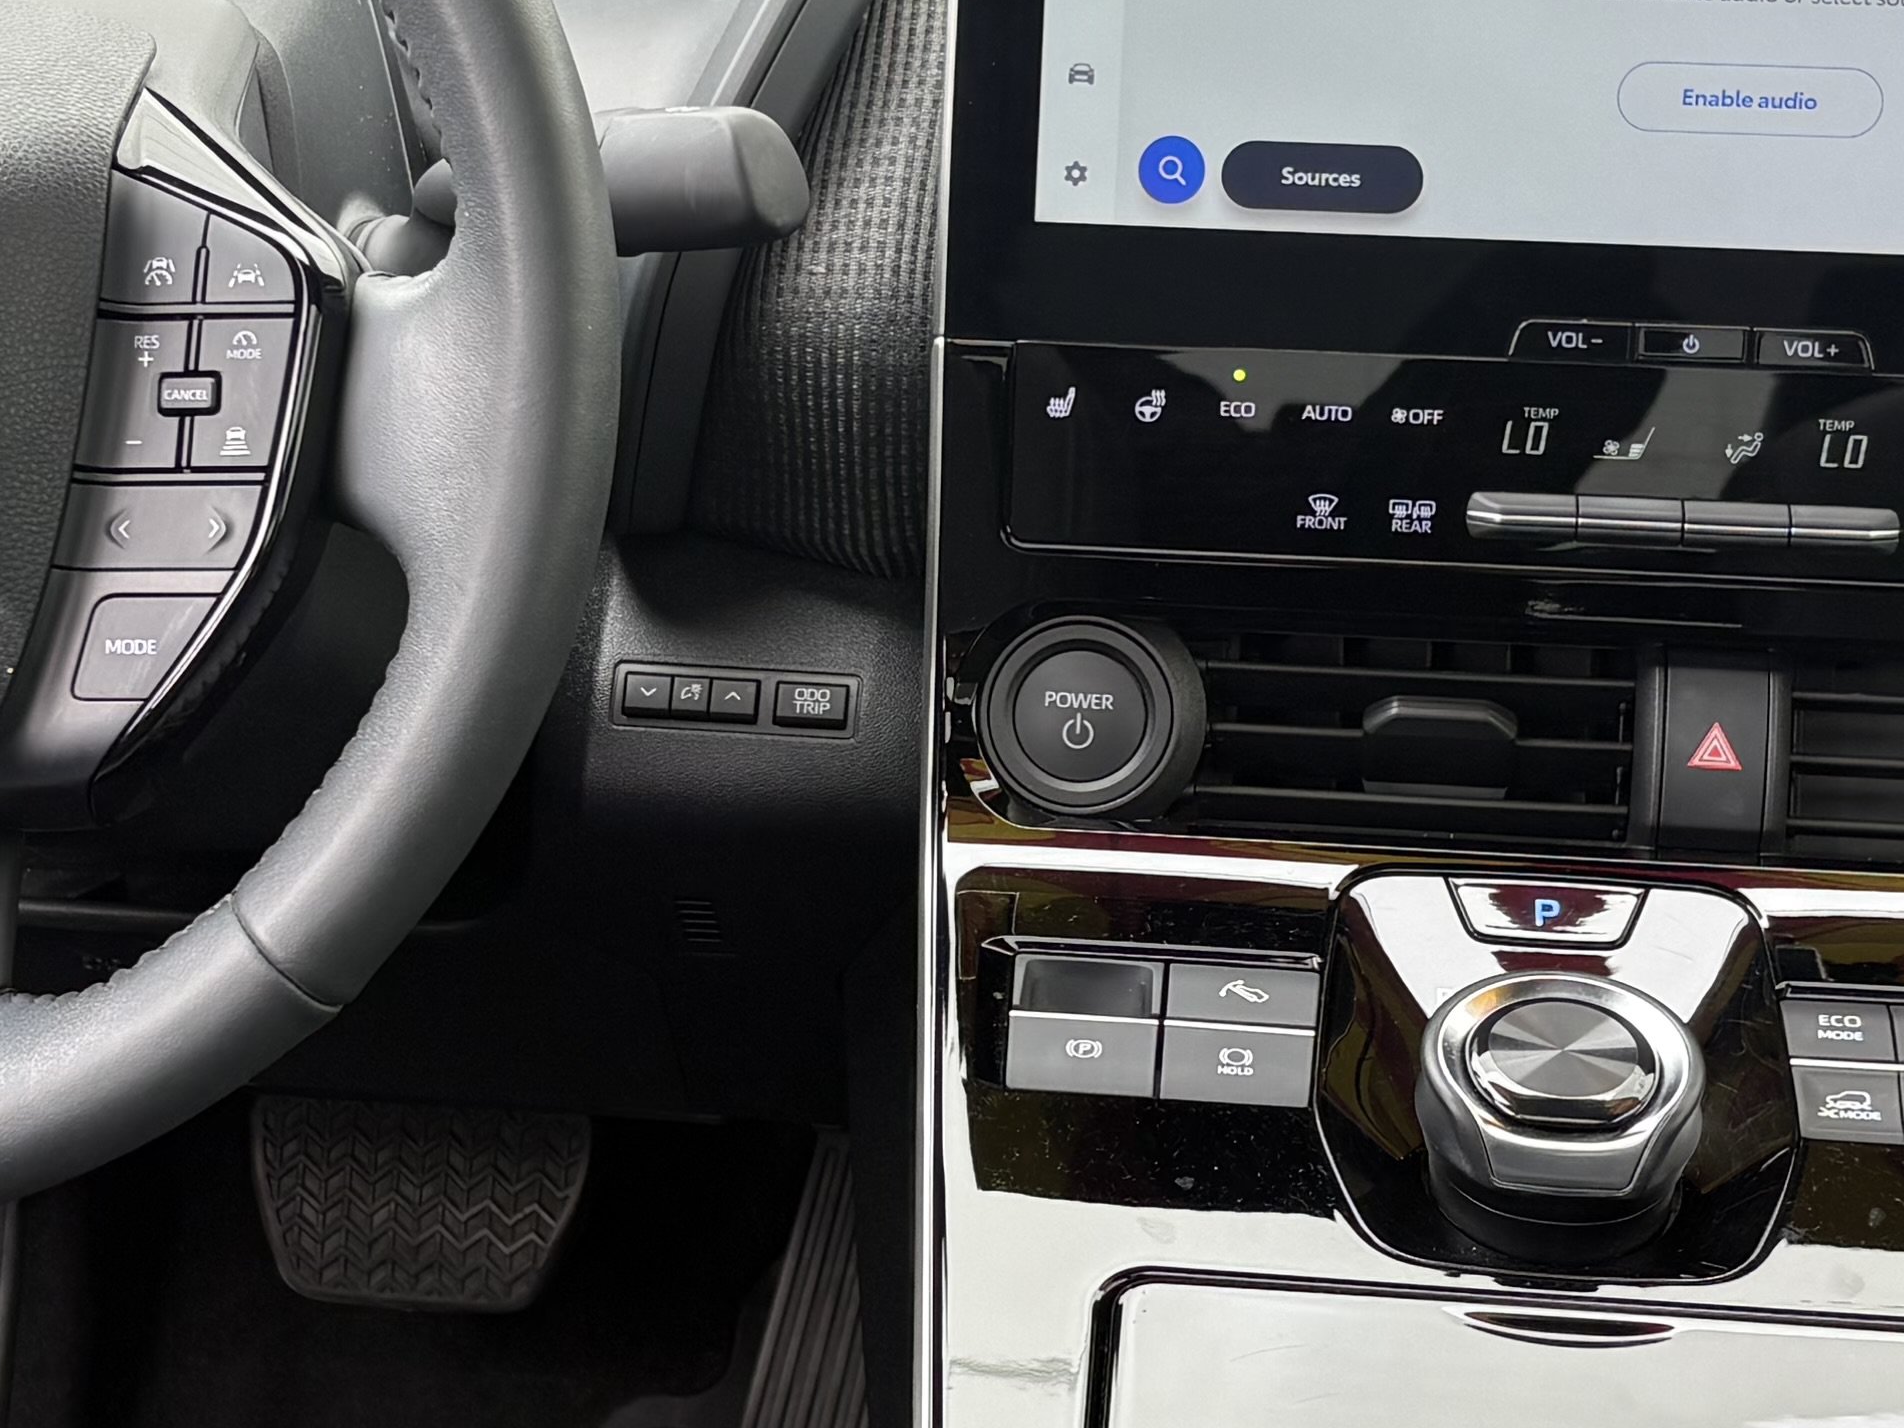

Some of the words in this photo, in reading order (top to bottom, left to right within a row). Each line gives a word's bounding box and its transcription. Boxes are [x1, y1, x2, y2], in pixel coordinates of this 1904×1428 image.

[1681, 88, 1754, 110] Enable
[1757, 90, 1818, 112] audio
[1280, 166, 1361, 189] Sources
[133, 334, 160, 349] RES
[225, 347, 262, 360] MODE
[163, 388, 209, 402] CANCEL
[1219, 400, 1256, 419] ECO
[1302, 404, 1353, 423] AUTO
[1408, 408, 1444, 426] OFF
[1523, 406, 1559, 419] TEMP
[1818, 418, 1855, 432] TEMP
[1296, 515, 1348, 532] FRONT
[1390, 518, 1433, 534] REAR
[104, 638, 157, 656] MODE
[794, 687, 831, 702] ODO
[1043, 691, 1114, 711] POWER
[792, 700, 831, 715] TRIP
[1534, 898, 1560, 926] P
[1818, 1014, 1862, 1028] ECO
[1817, 1029, 1864, 1042] MODE
[1216, 1063, 1254, 1076] HOLD
